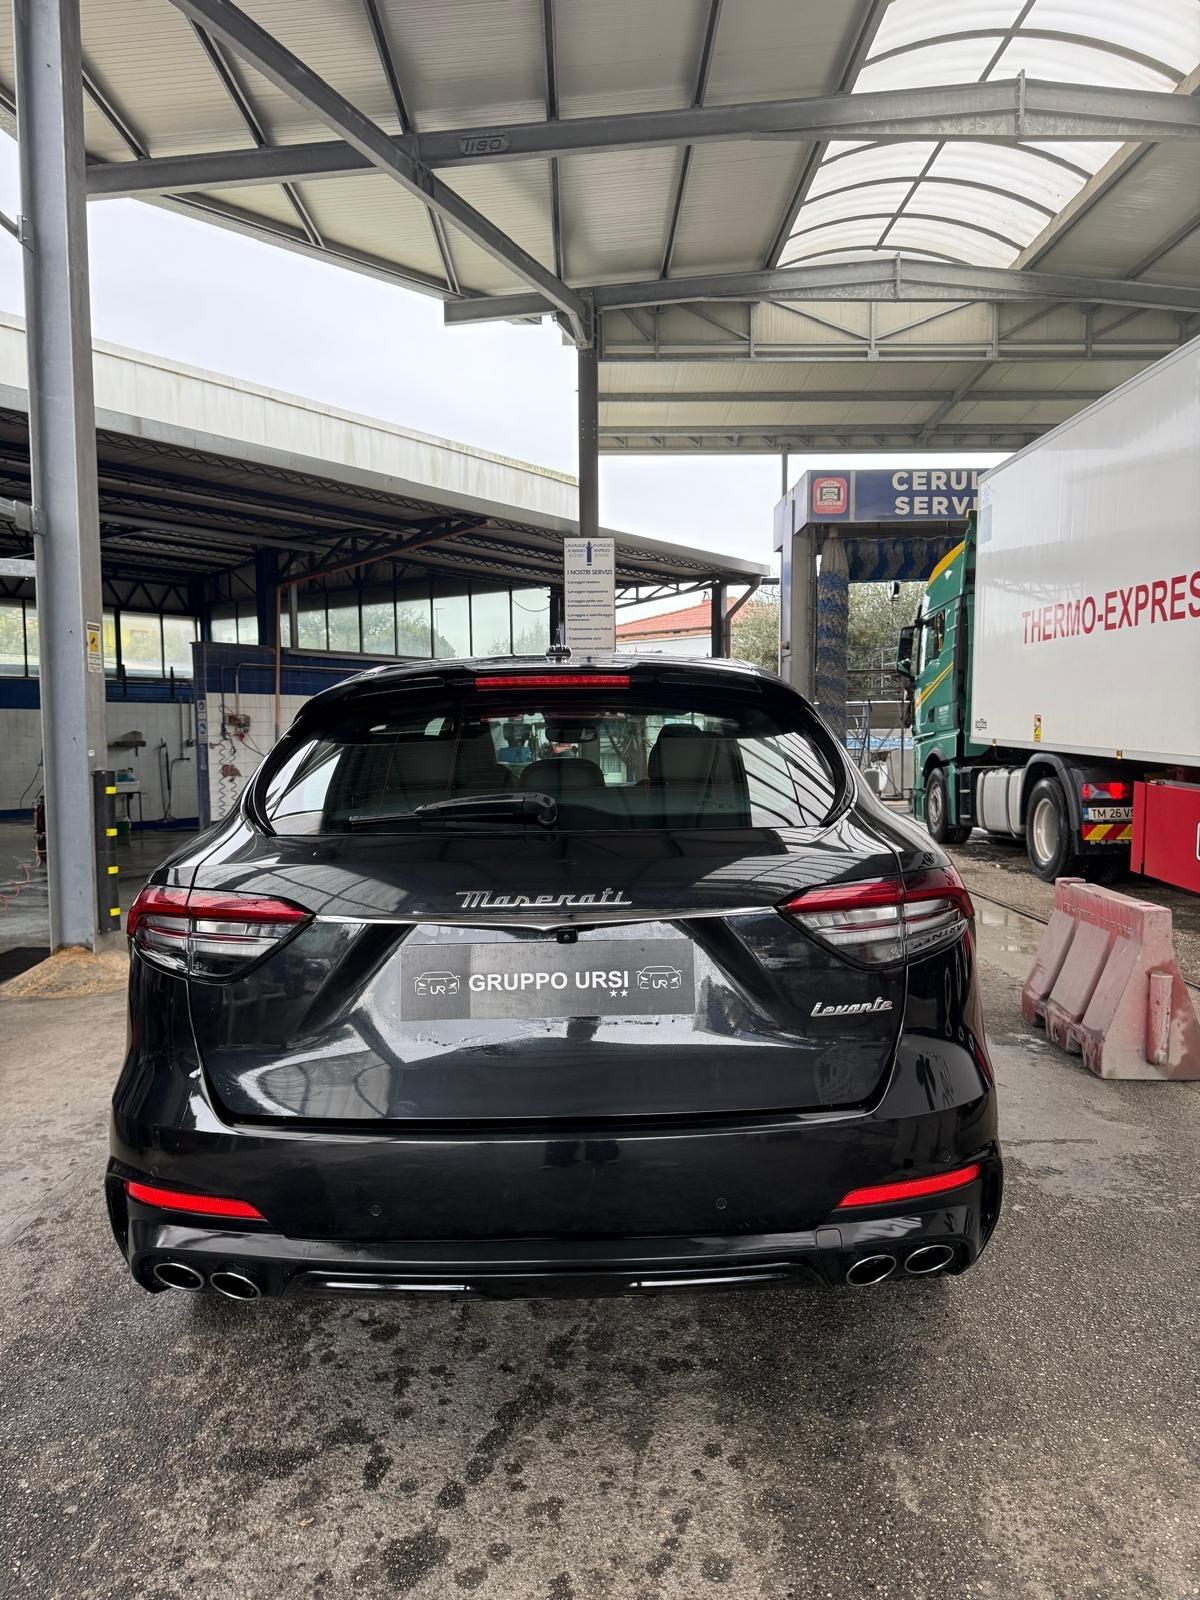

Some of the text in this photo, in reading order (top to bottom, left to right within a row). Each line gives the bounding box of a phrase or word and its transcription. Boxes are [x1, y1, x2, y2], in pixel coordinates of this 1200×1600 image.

[1091, 808, 1106, 819] TM
[1109, 808, 1121, 819] 26
[456, 887, 632, 908] Maserati
[811, 996, 893, 1017] Levante
